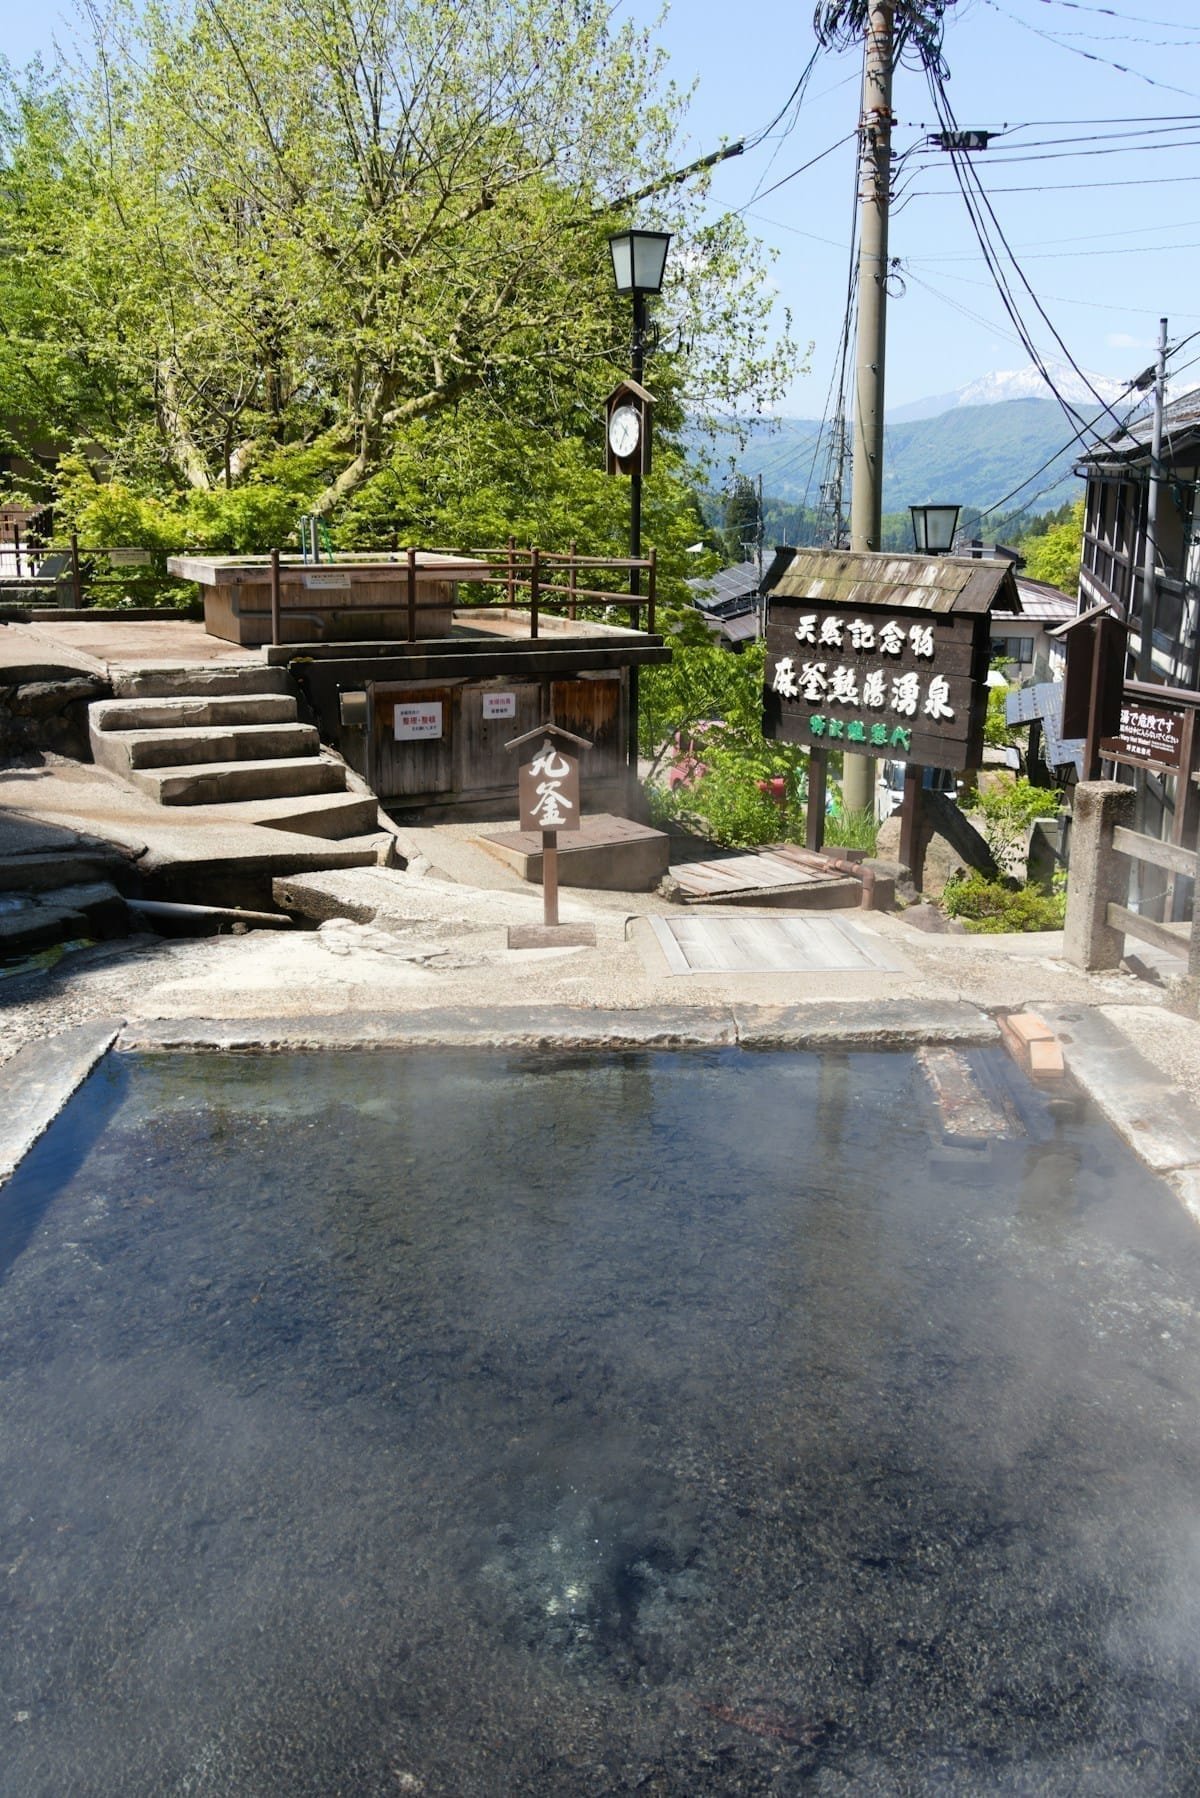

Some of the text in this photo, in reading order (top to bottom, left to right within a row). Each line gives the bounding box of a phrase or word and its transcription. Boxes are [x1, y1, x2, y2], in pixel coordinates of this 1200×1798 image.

[795, 614, 935, 658] 天然記念物
[772, 657, 954, 719] 麻釜熱湯湧泉
[529, 738, 573, 826] 丸釜
